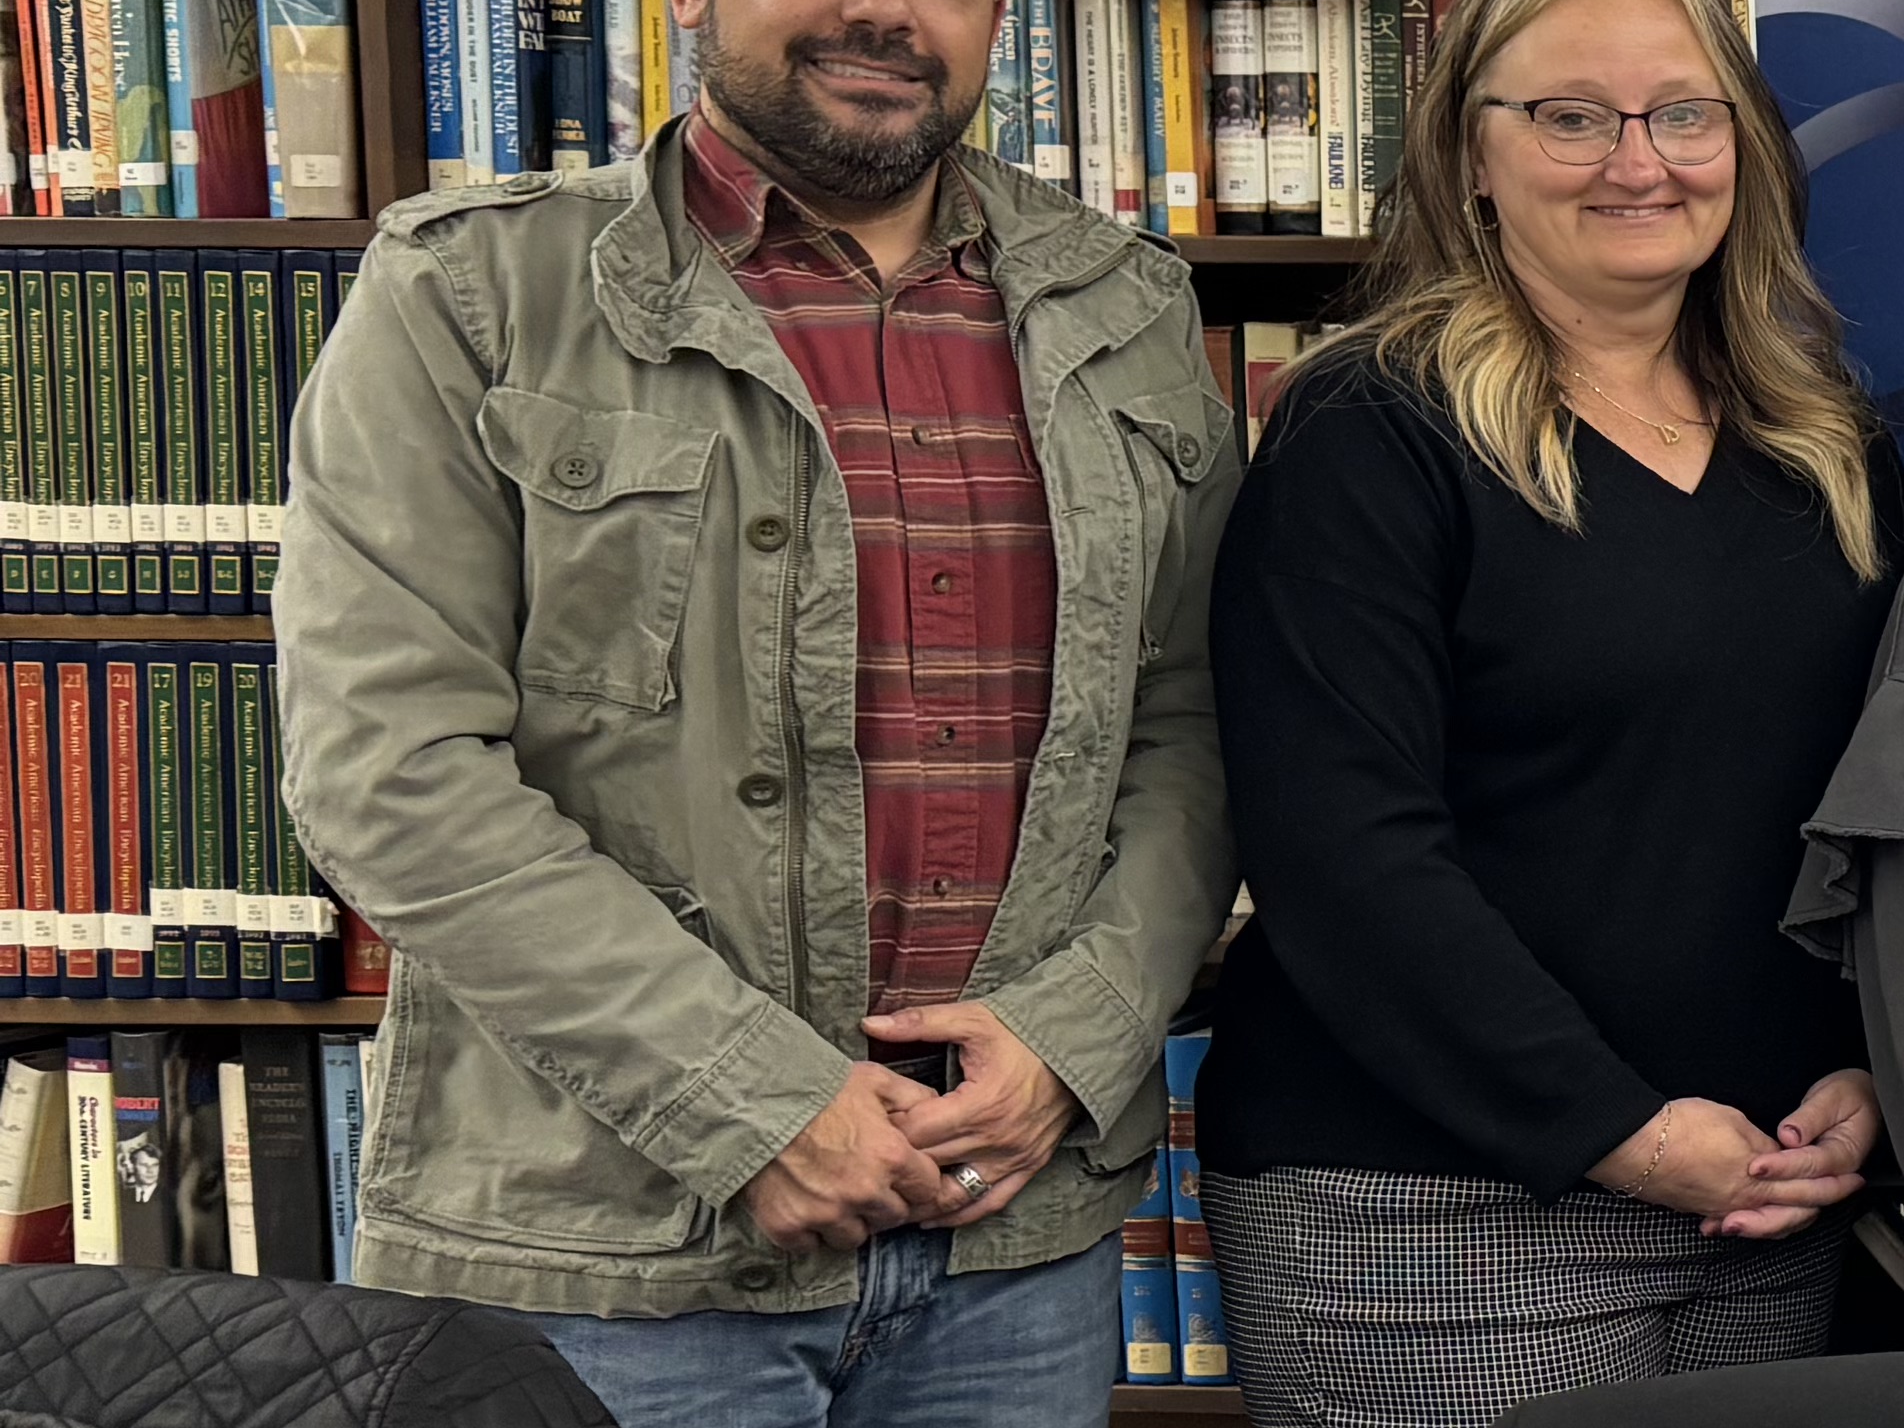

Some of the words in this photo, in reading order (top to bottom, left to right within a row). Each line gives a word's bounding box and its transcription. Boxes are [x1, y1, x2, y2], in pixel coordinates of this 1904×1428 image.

[551, 11, 584, 23] BOAT
[165, 29, 182, 82] SHORTS
[128, 281, 147, 298] 10
[26, 281, 37, 297] 7
[32, 374, 46, 434] American
[134, 374, 148, 434] American
[112, 674, 131, 688] 21
[153, 673, 172, 688] 17
[117, 699, 130, 759] Academic
[119, 764, 132, 823] American
[161, 764, 171, 824] American
